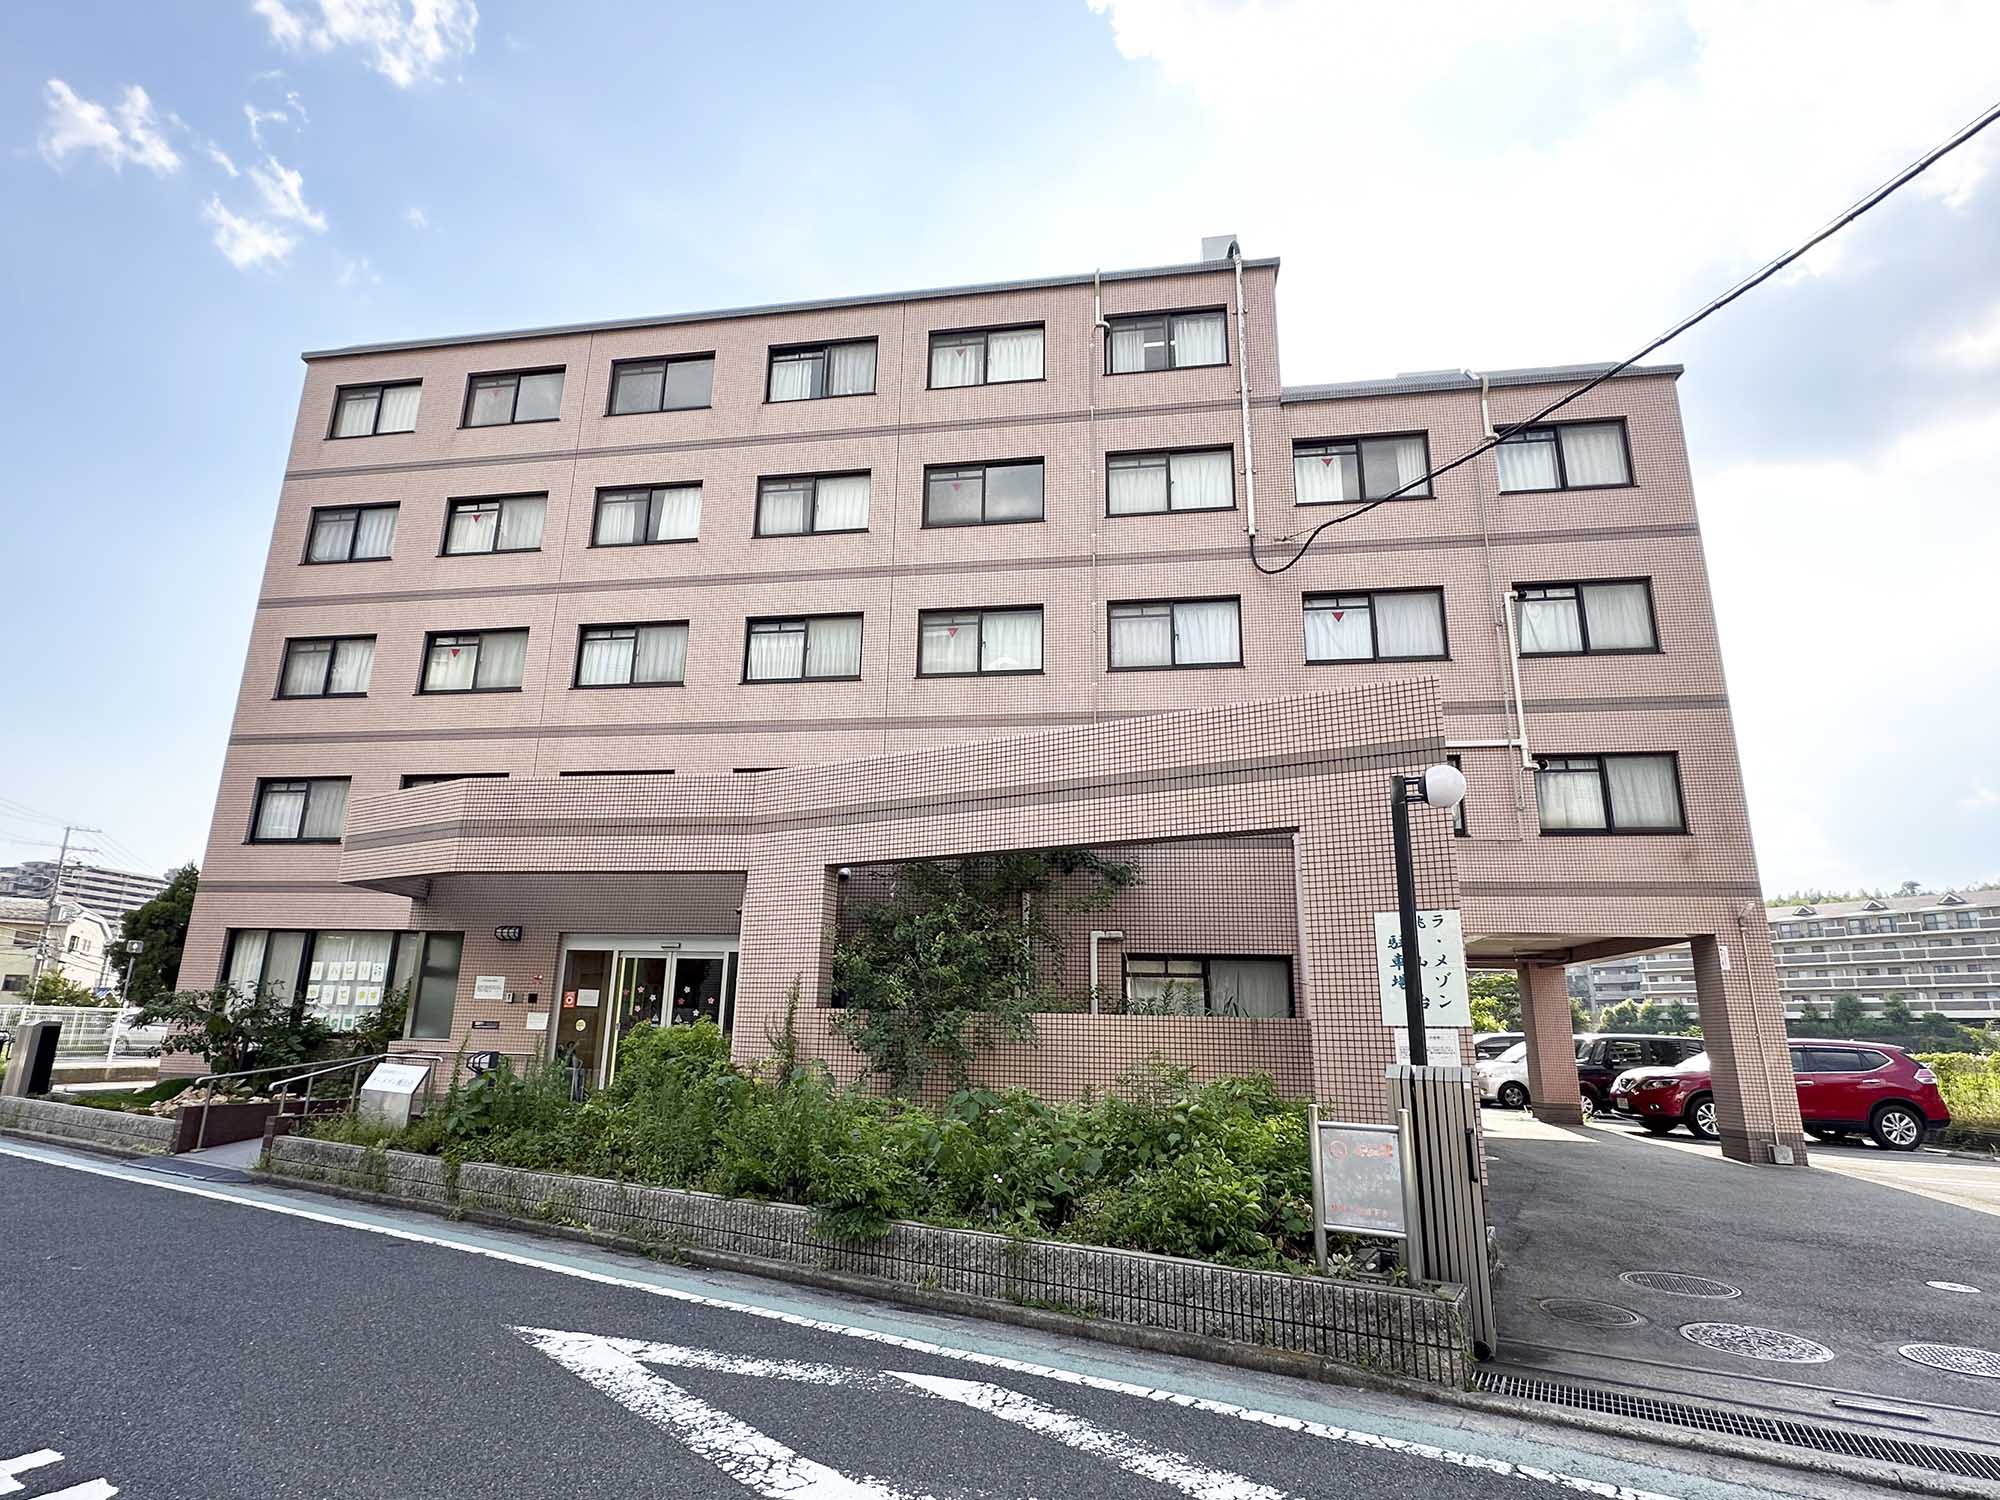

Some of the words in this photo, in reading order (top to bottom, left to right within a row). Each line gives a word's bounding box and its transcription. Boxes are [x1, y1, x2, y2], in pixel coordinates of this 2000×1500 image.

[1432, 914, 1452, 1009] ラ・メゾン
